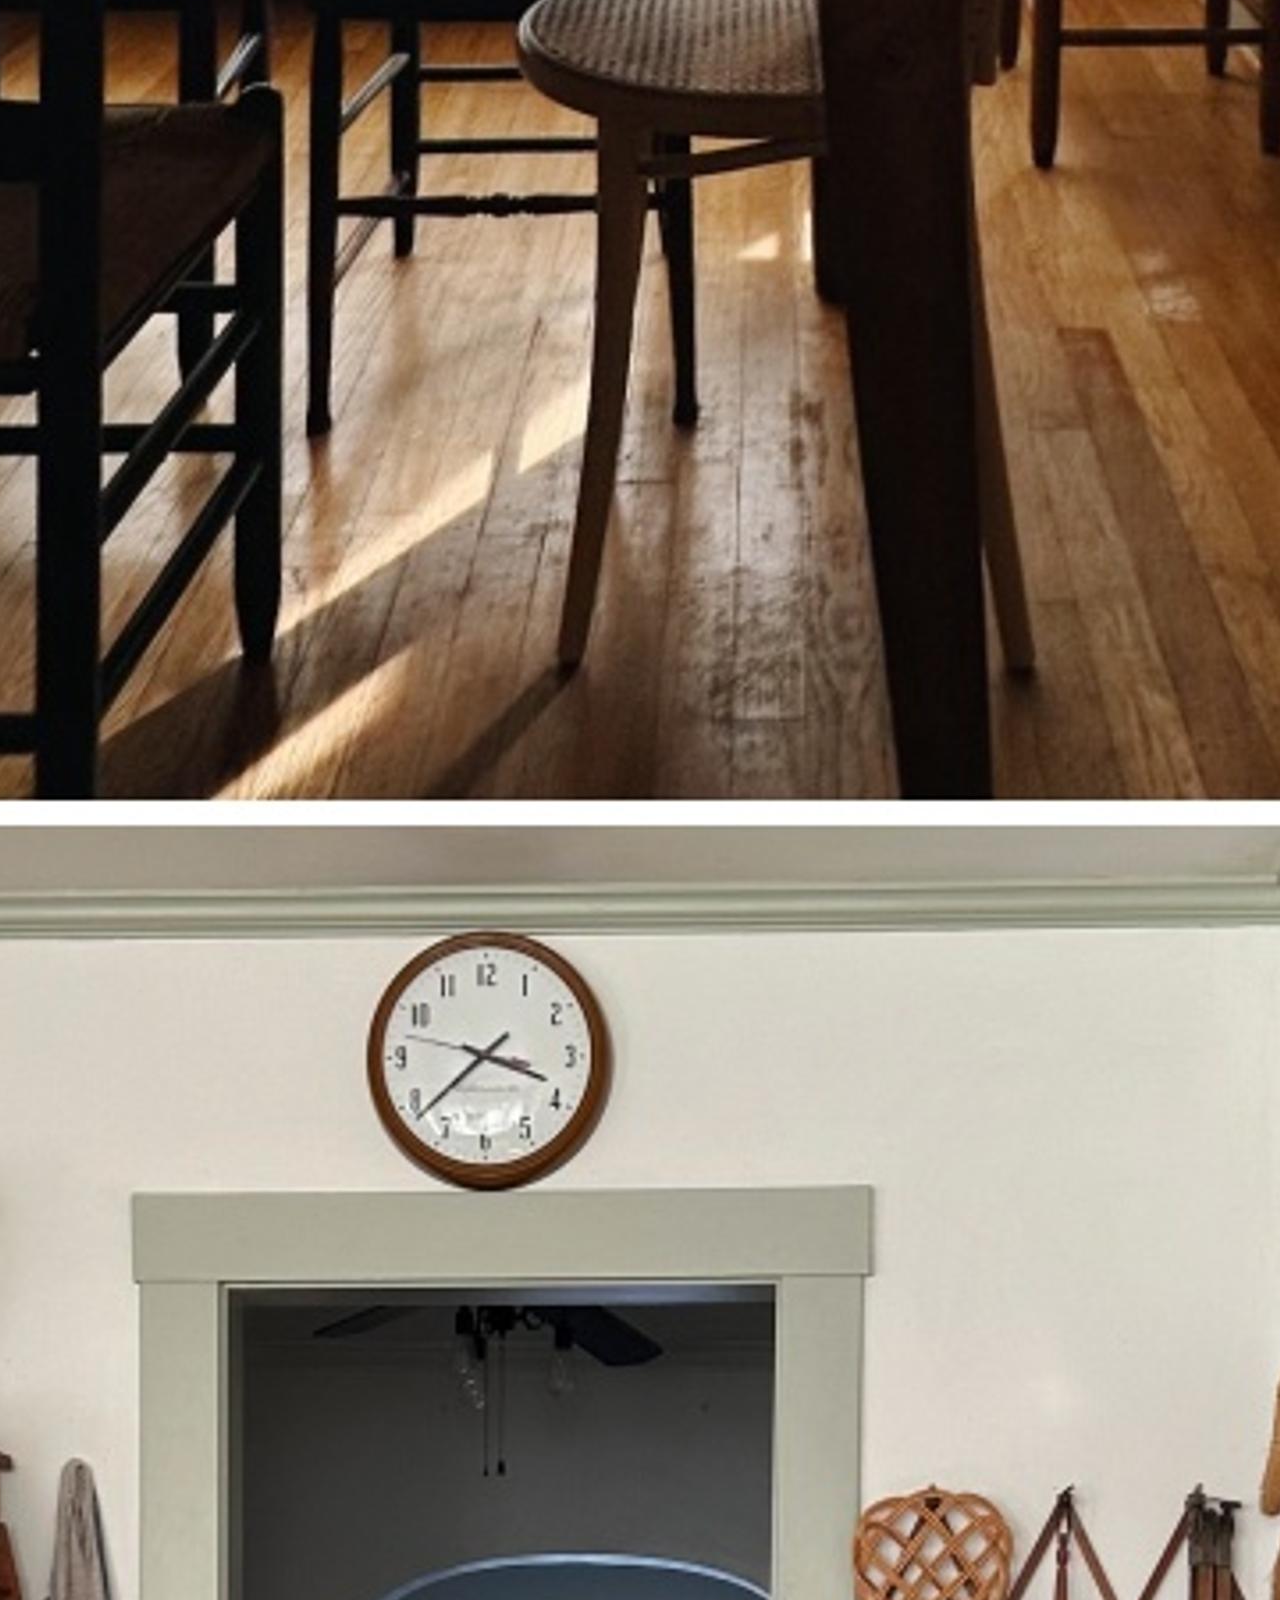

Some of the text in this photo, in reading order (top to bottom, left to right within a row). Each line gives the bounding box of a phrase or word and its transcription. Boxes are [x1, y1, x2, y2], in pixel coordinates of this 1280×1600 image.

[441, 974, 456, 997] 11
[476, 963, 497, 986] 12
[412, 1003, 431, 1028] 10
[551, 1002, 562, 1026] 2
[395, 1045, 407, 1070] 9
[565, 1044, 577, 1068] 3
[550, 1087, 562, 1111] 4
[440, 1116, 452, 1139] 7
[519, 1116, 531, 1140] 5
[480, 1132, 491, 1150] 6
